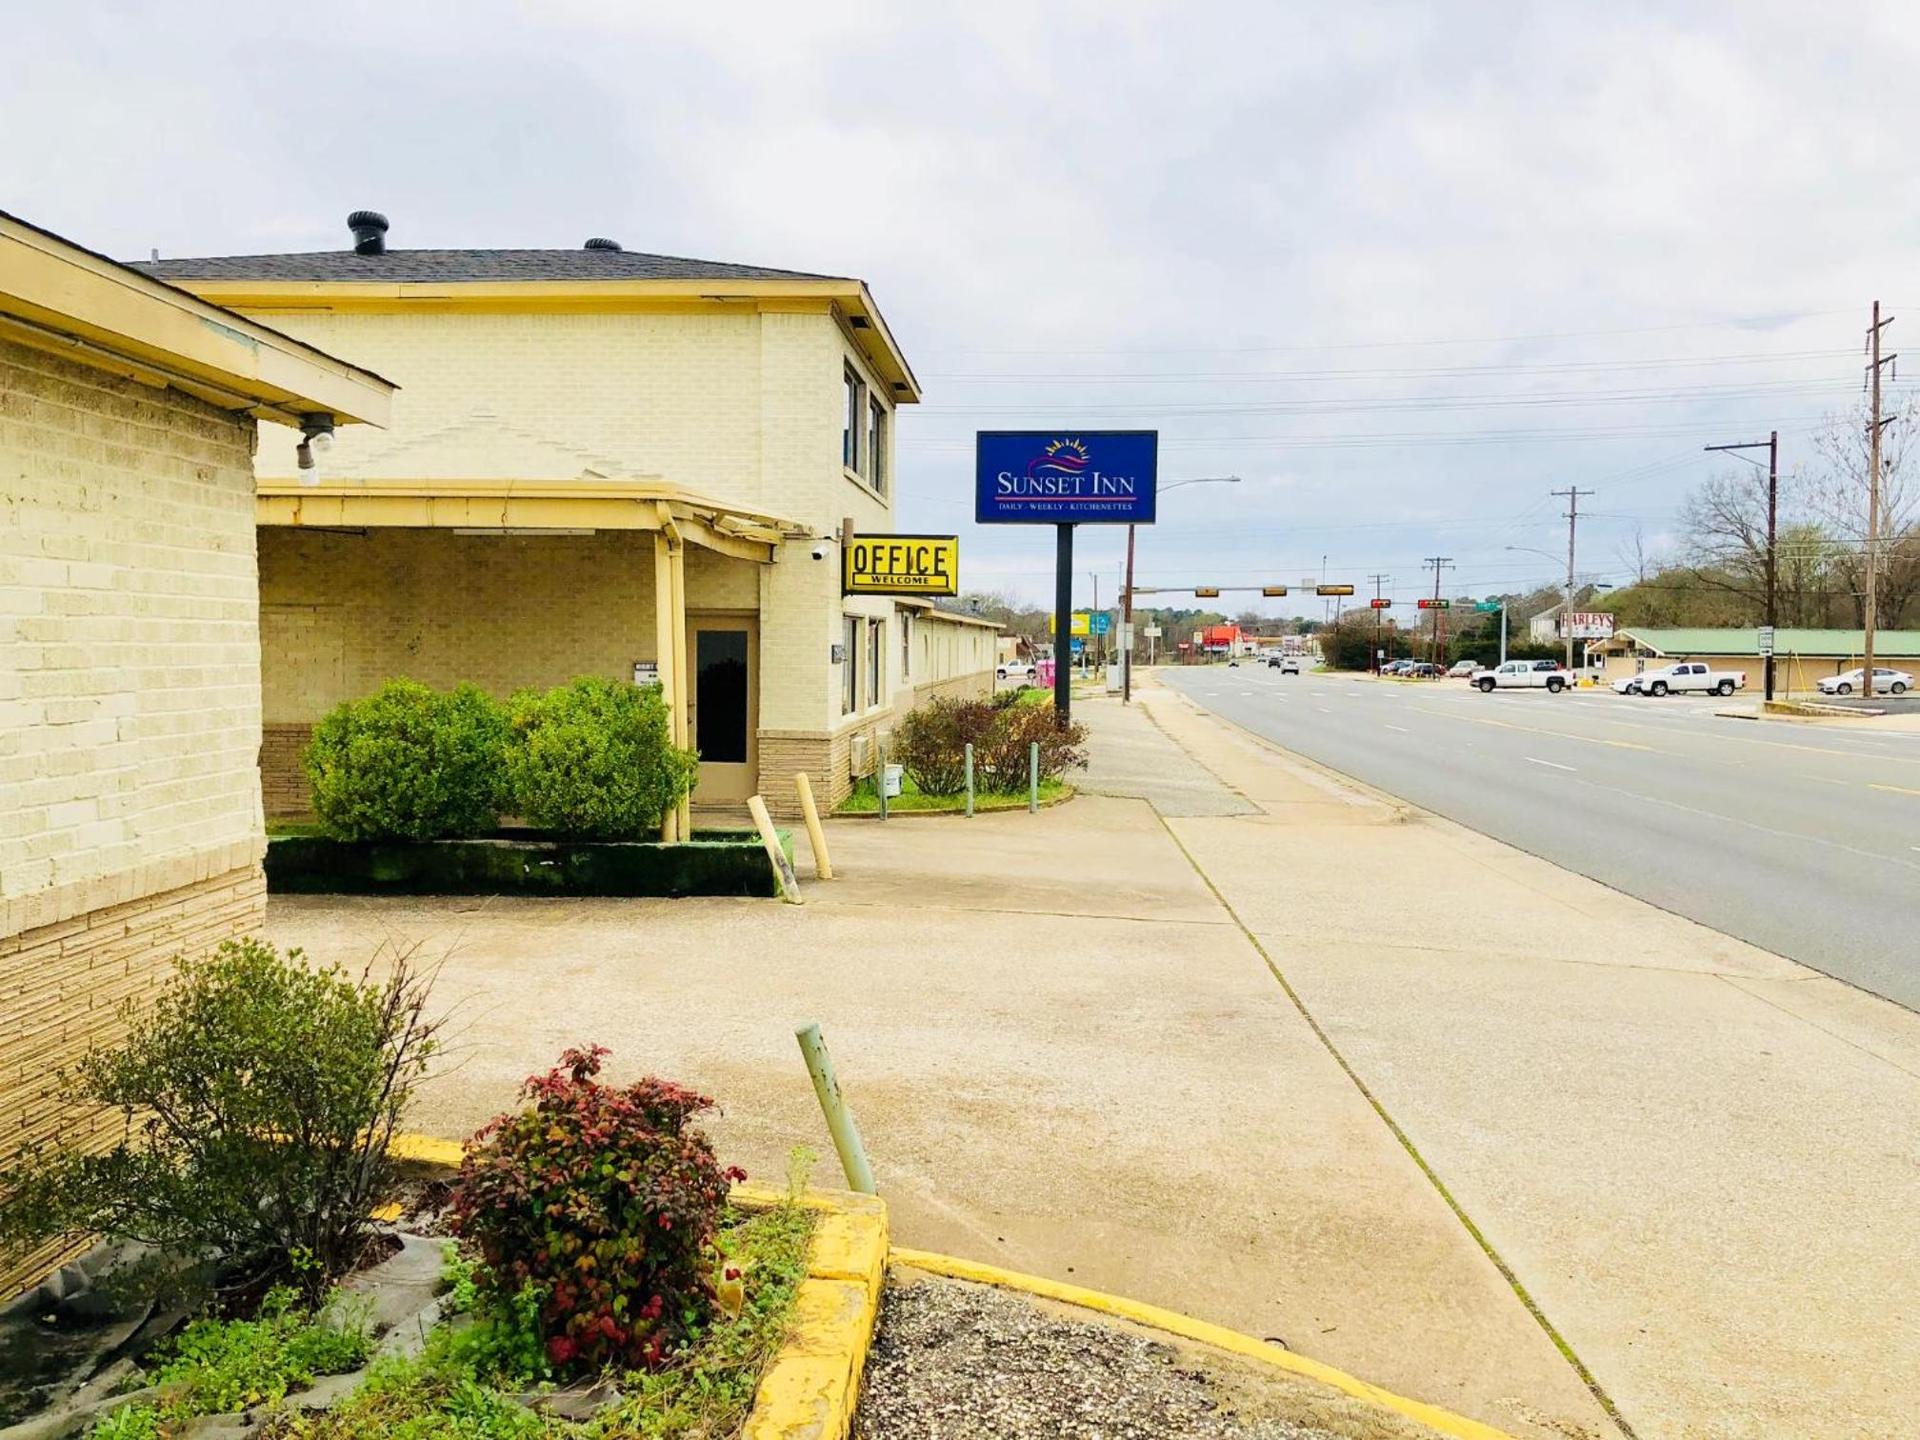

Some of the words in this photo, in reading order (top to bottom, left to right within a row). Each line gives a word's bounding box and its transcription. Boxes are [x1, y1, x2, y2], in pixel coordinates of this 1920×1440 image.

[997, 471, 1085, 494] SUNSET
[1093, 471, 1135, 494] INN
[998, 503, 1022, 511] DAILY
[1029, 503, 1063, 511] WEEKLY
[1070, 503, 1132, 511] KITCHENETTES
[854, 545, 948, 575] OFFICE
[871, 575, 929, 585] WELCOME
